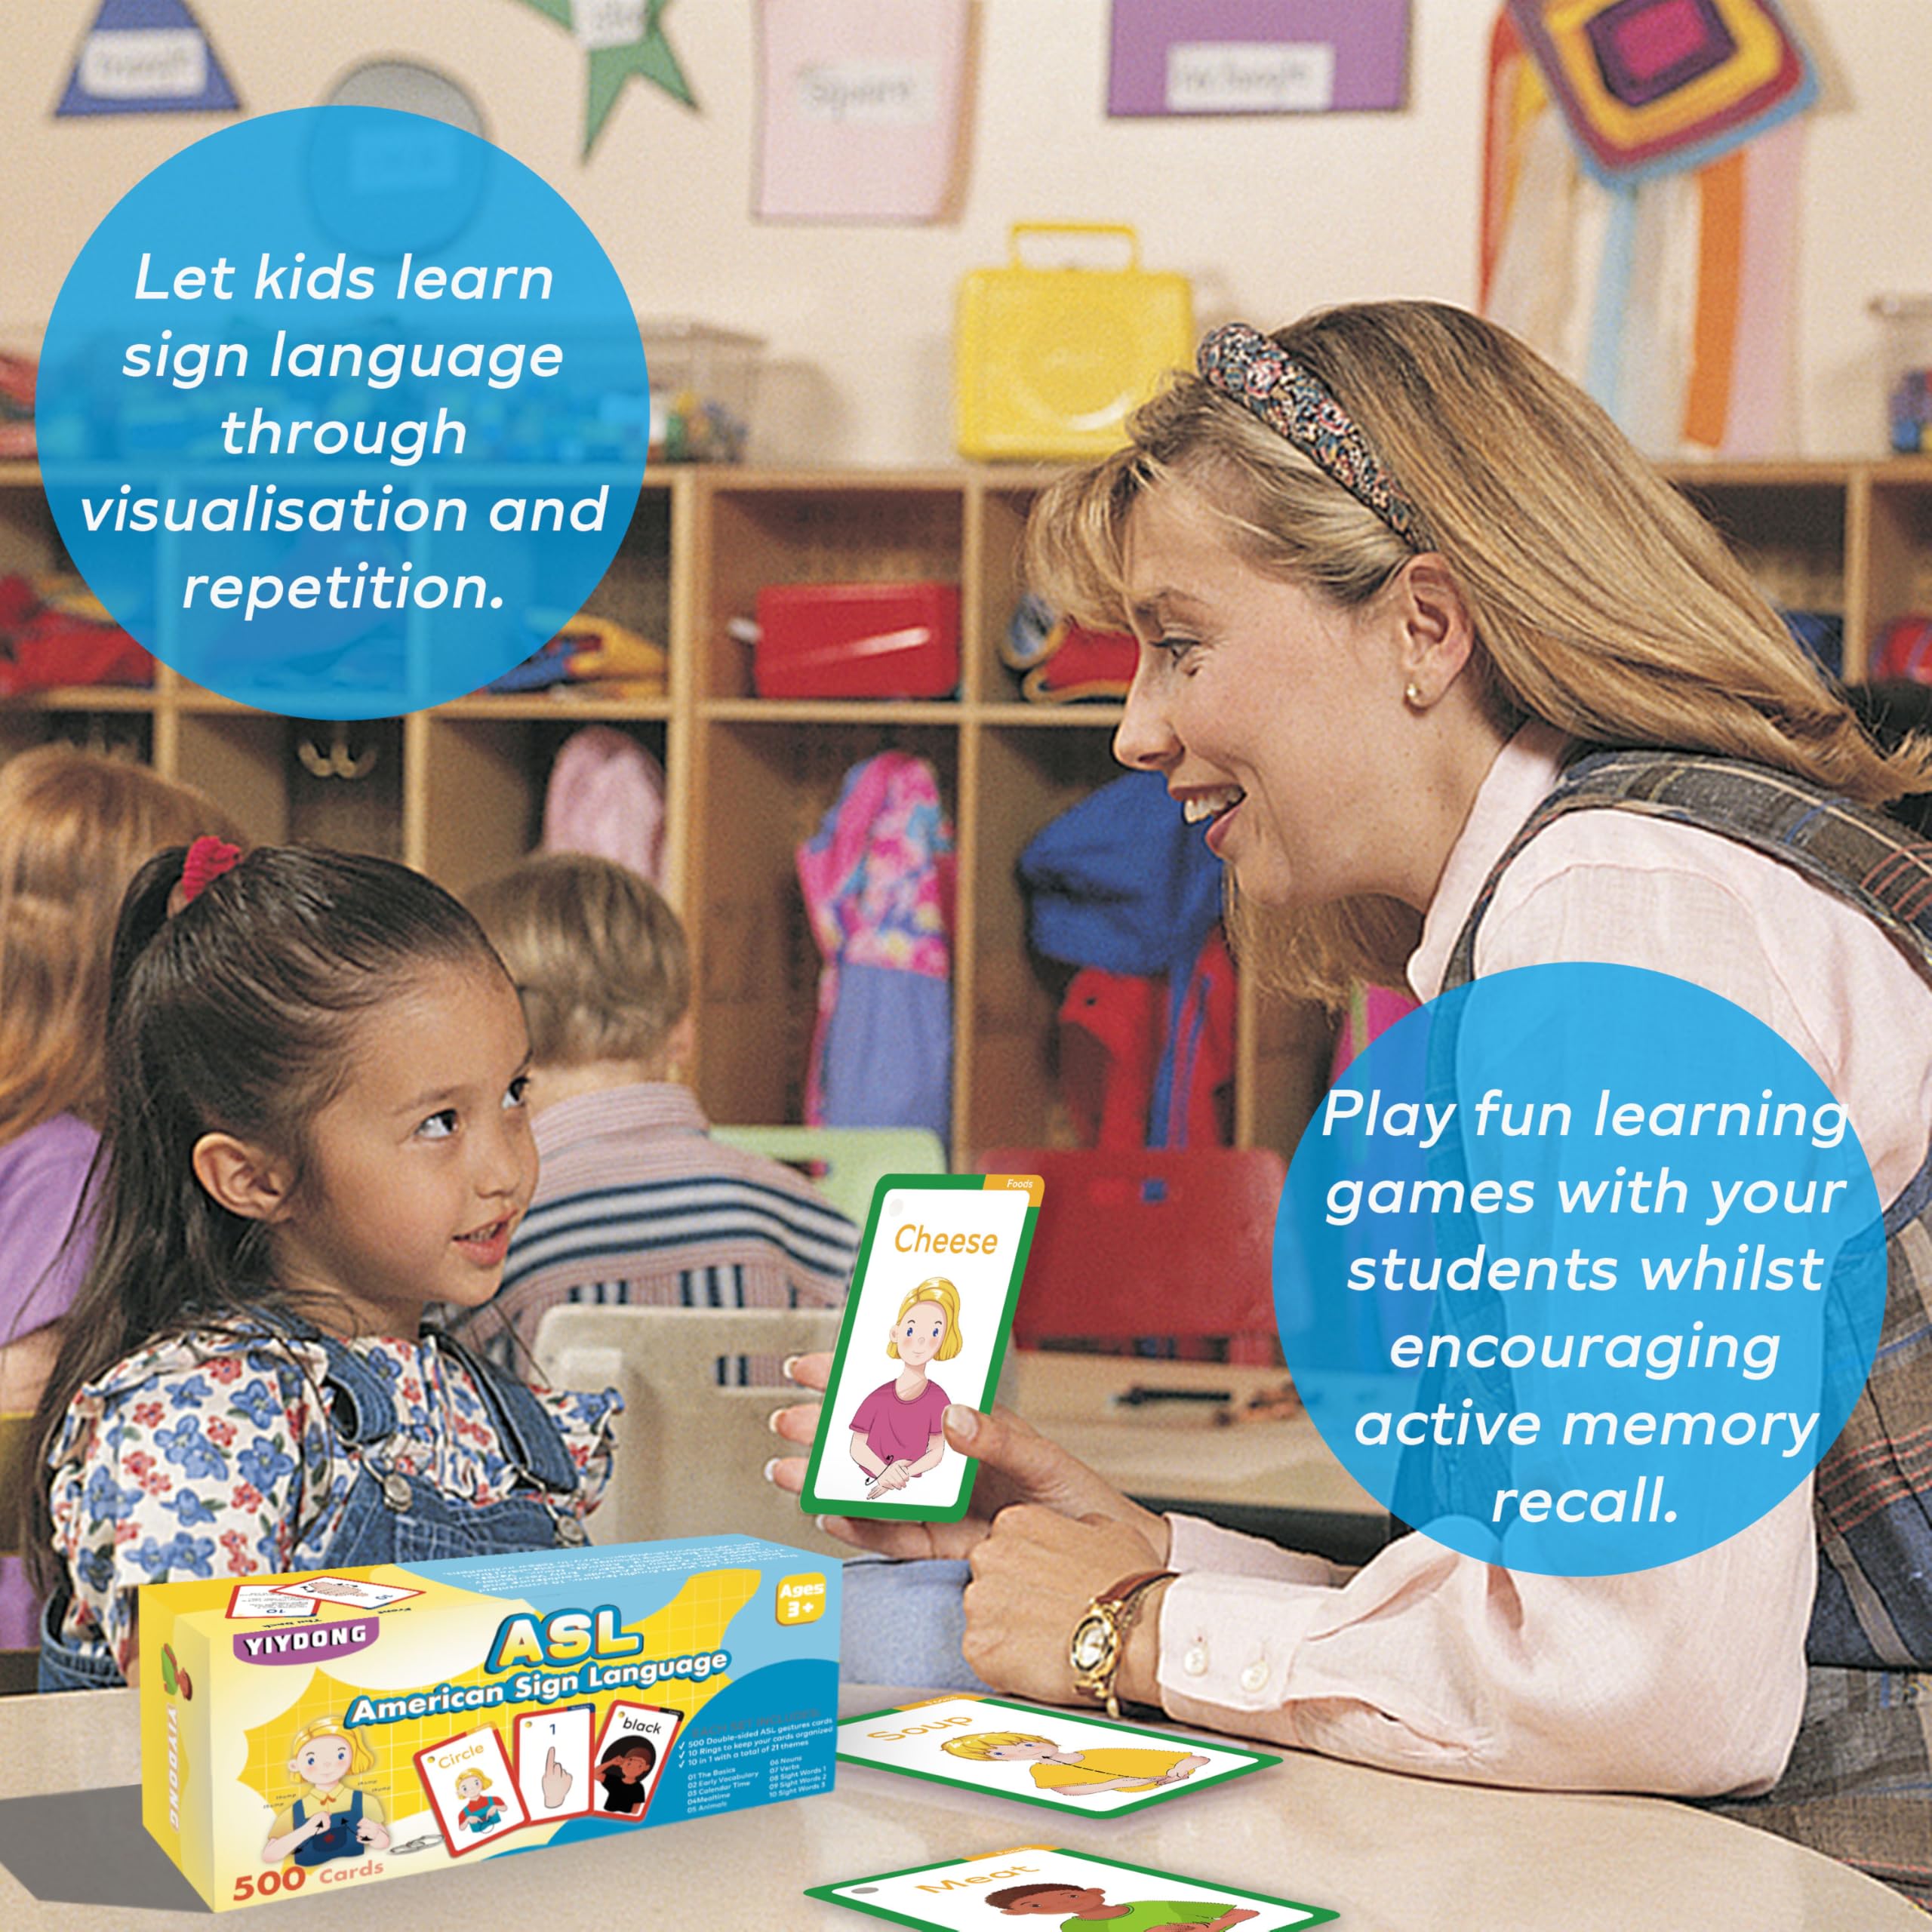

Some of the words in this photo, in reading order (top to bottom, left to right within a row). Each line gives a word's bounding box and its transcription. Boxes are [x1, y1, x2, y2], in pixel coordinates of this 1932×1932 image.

[1006, 1178, 1033, 1189] Foods
[894, 1223, 998, 1255] Cheese
[780, 1583, 825, 1598] Ages
[245, 1625, 366, 1656] YIYDONG
[495, 1607, 641, 1669] ASL
[351, 1686, 504, 1723] American
[515, 1673, 579, 1699] Sign
[589, 1654, 728, 1687] Language
[550, 1724, 556, 1735] 1
[622, 1717, 662, 1734] black
[688, 1739, 705, 1748] 500
[706, 1730, 758, 1745] Double-sided
[778, 1721, 810, 1734] gestures
[811, 1718, 833, 1727] cards
[692, 1724, 726, 1738] EACH
[867, 1716, 973, 1741] Soup
[700, 1746, 721, 1755] Rings
[734, 1741, 752, 1749] keep
[755, 1737, 771, 1747] your
[773, 1733, 794, 1743] cards
[795, 1726, 833, 1738] organized
[714, 1753, 731, 1761] with
[740, 1747, 759, 1757] total
[780, 1740, 809, 1749] themes
[438, 1744, 485, 1768] Circle
[168, 1706, 180, 1831] YIYDONG
[699, 1778, 717, 1787] Early
[718, 1771, 759, 1783] Vocabulary
[712, 1767, 736, 1776] Basics
[780, 1772, 798, 1780] Sight
[800, 1767, 821, 1776] Words
[699, 1784, 731, 1795] Calendar
[778, 1788, 797, 1796] Sight
[798, 1784, 820, 1792] Words
[780, 1780, 798, 1788] Sight
[799, 1776, 821, 1784] Words
[233, 1866, 306, 1901] 500
[319, 1860, 384, 1884] Cards
[915, 1866, 1041, 1894] Meat
